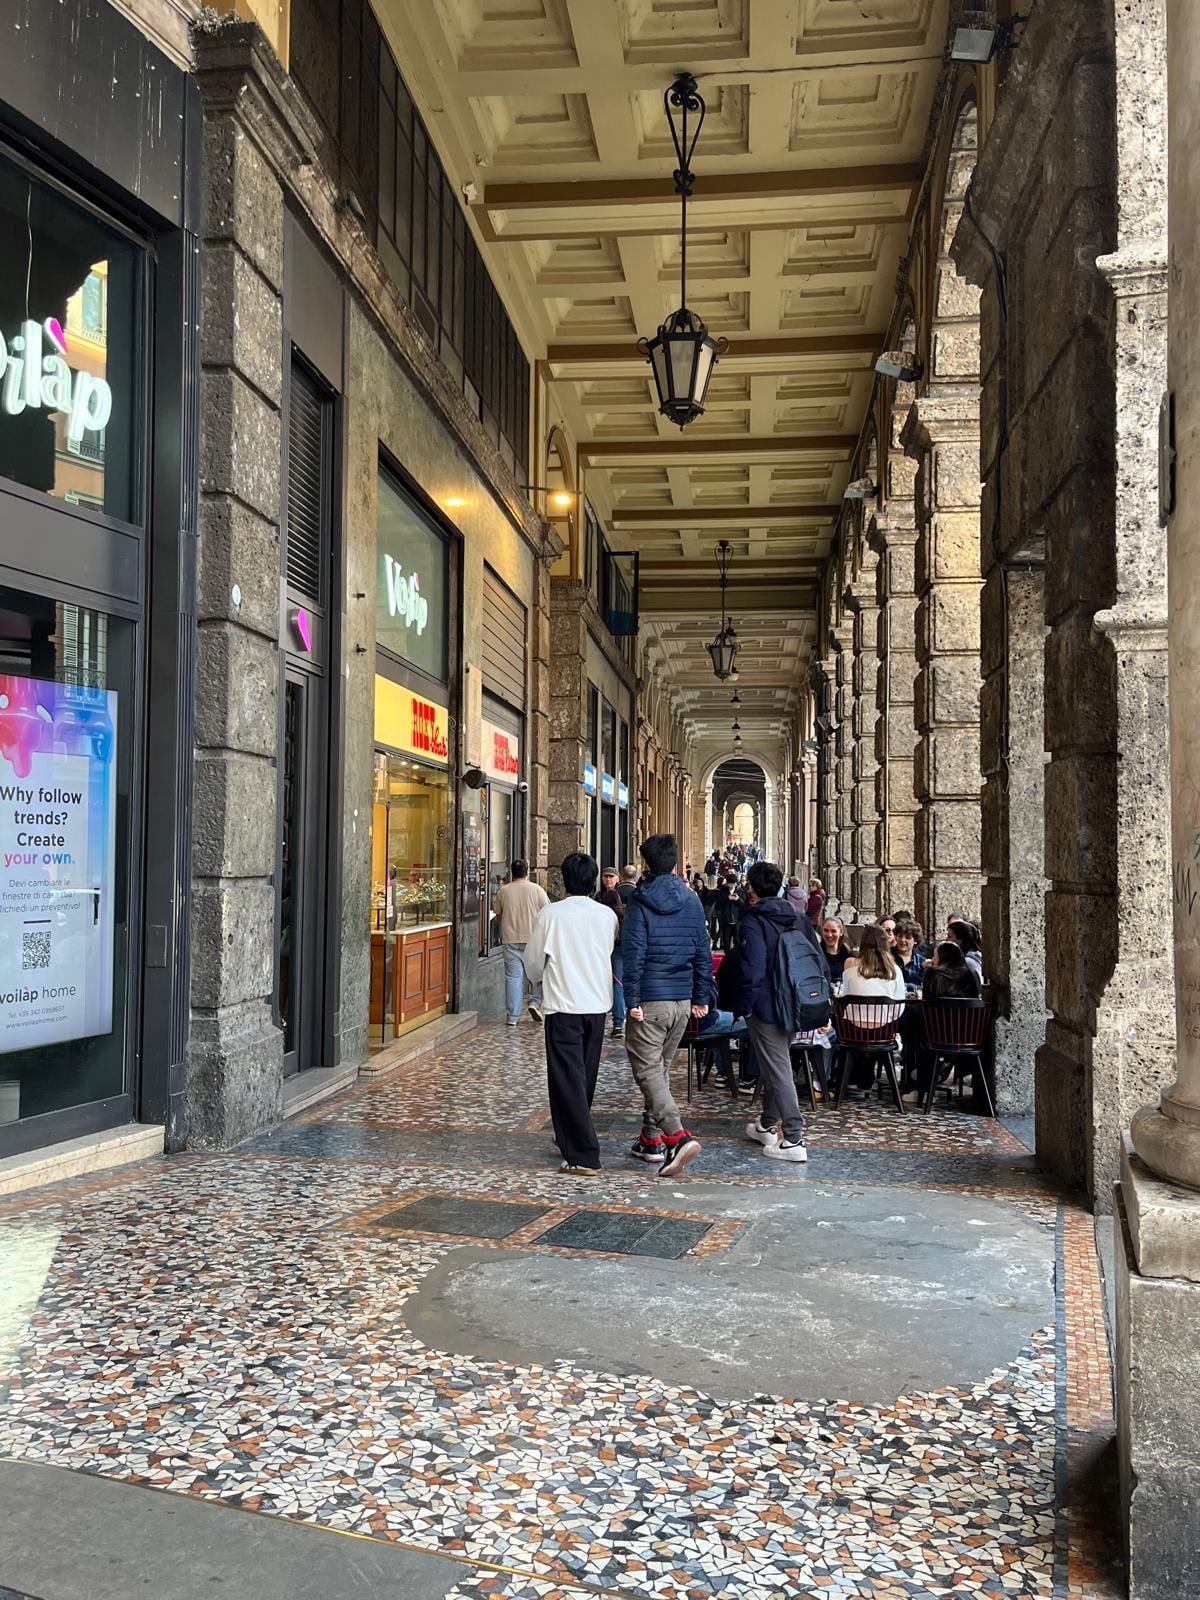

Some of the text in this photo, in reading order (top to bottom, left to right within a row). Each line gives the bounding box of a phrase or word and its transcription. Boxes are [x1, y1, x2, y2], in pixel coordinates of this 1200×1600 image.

[0, 317, 112, 454] ilàp
[0, 786, 82, 804] Why follow
[14, 811, 68, 825] trends?
[17, 833, 65, 847] Create
[4, 854, 75, 867] your own.
[2, 891, 32, 900] finestre
[41, 902, 81, 911] preventivo!
[42, 986, 76, 999] home
